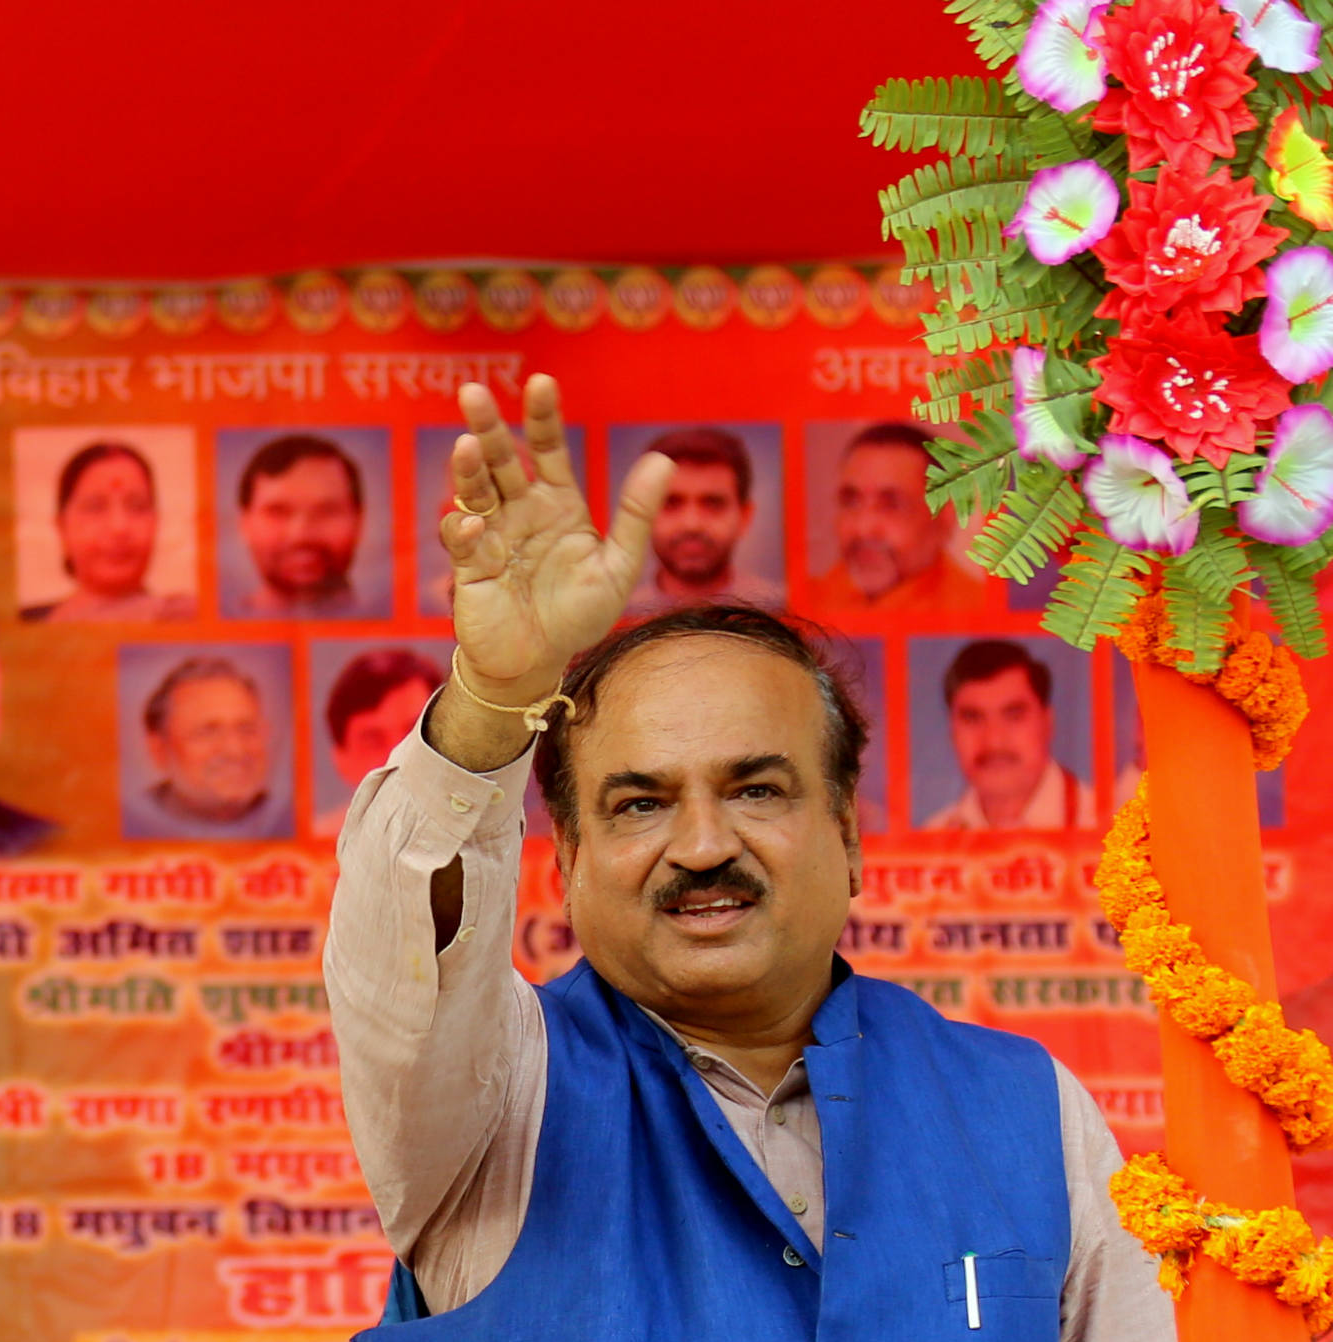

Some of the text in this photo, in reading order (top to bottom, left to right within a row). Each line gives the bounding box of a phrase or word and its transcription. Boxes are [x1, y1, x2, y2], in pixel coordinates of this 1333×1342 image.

[146, 352, 329, 399] भाजपा
[340, 352, 524, 398] सरकार
[237, 861, 307, 902] की
[990, 853, 1057, 894] की
[57, 919, 197, 960] अमित
[219, 926, 314, 960] शाह
[930, 921, 1071, 951] जनता
[147, 1152, 207, 1182] 18
